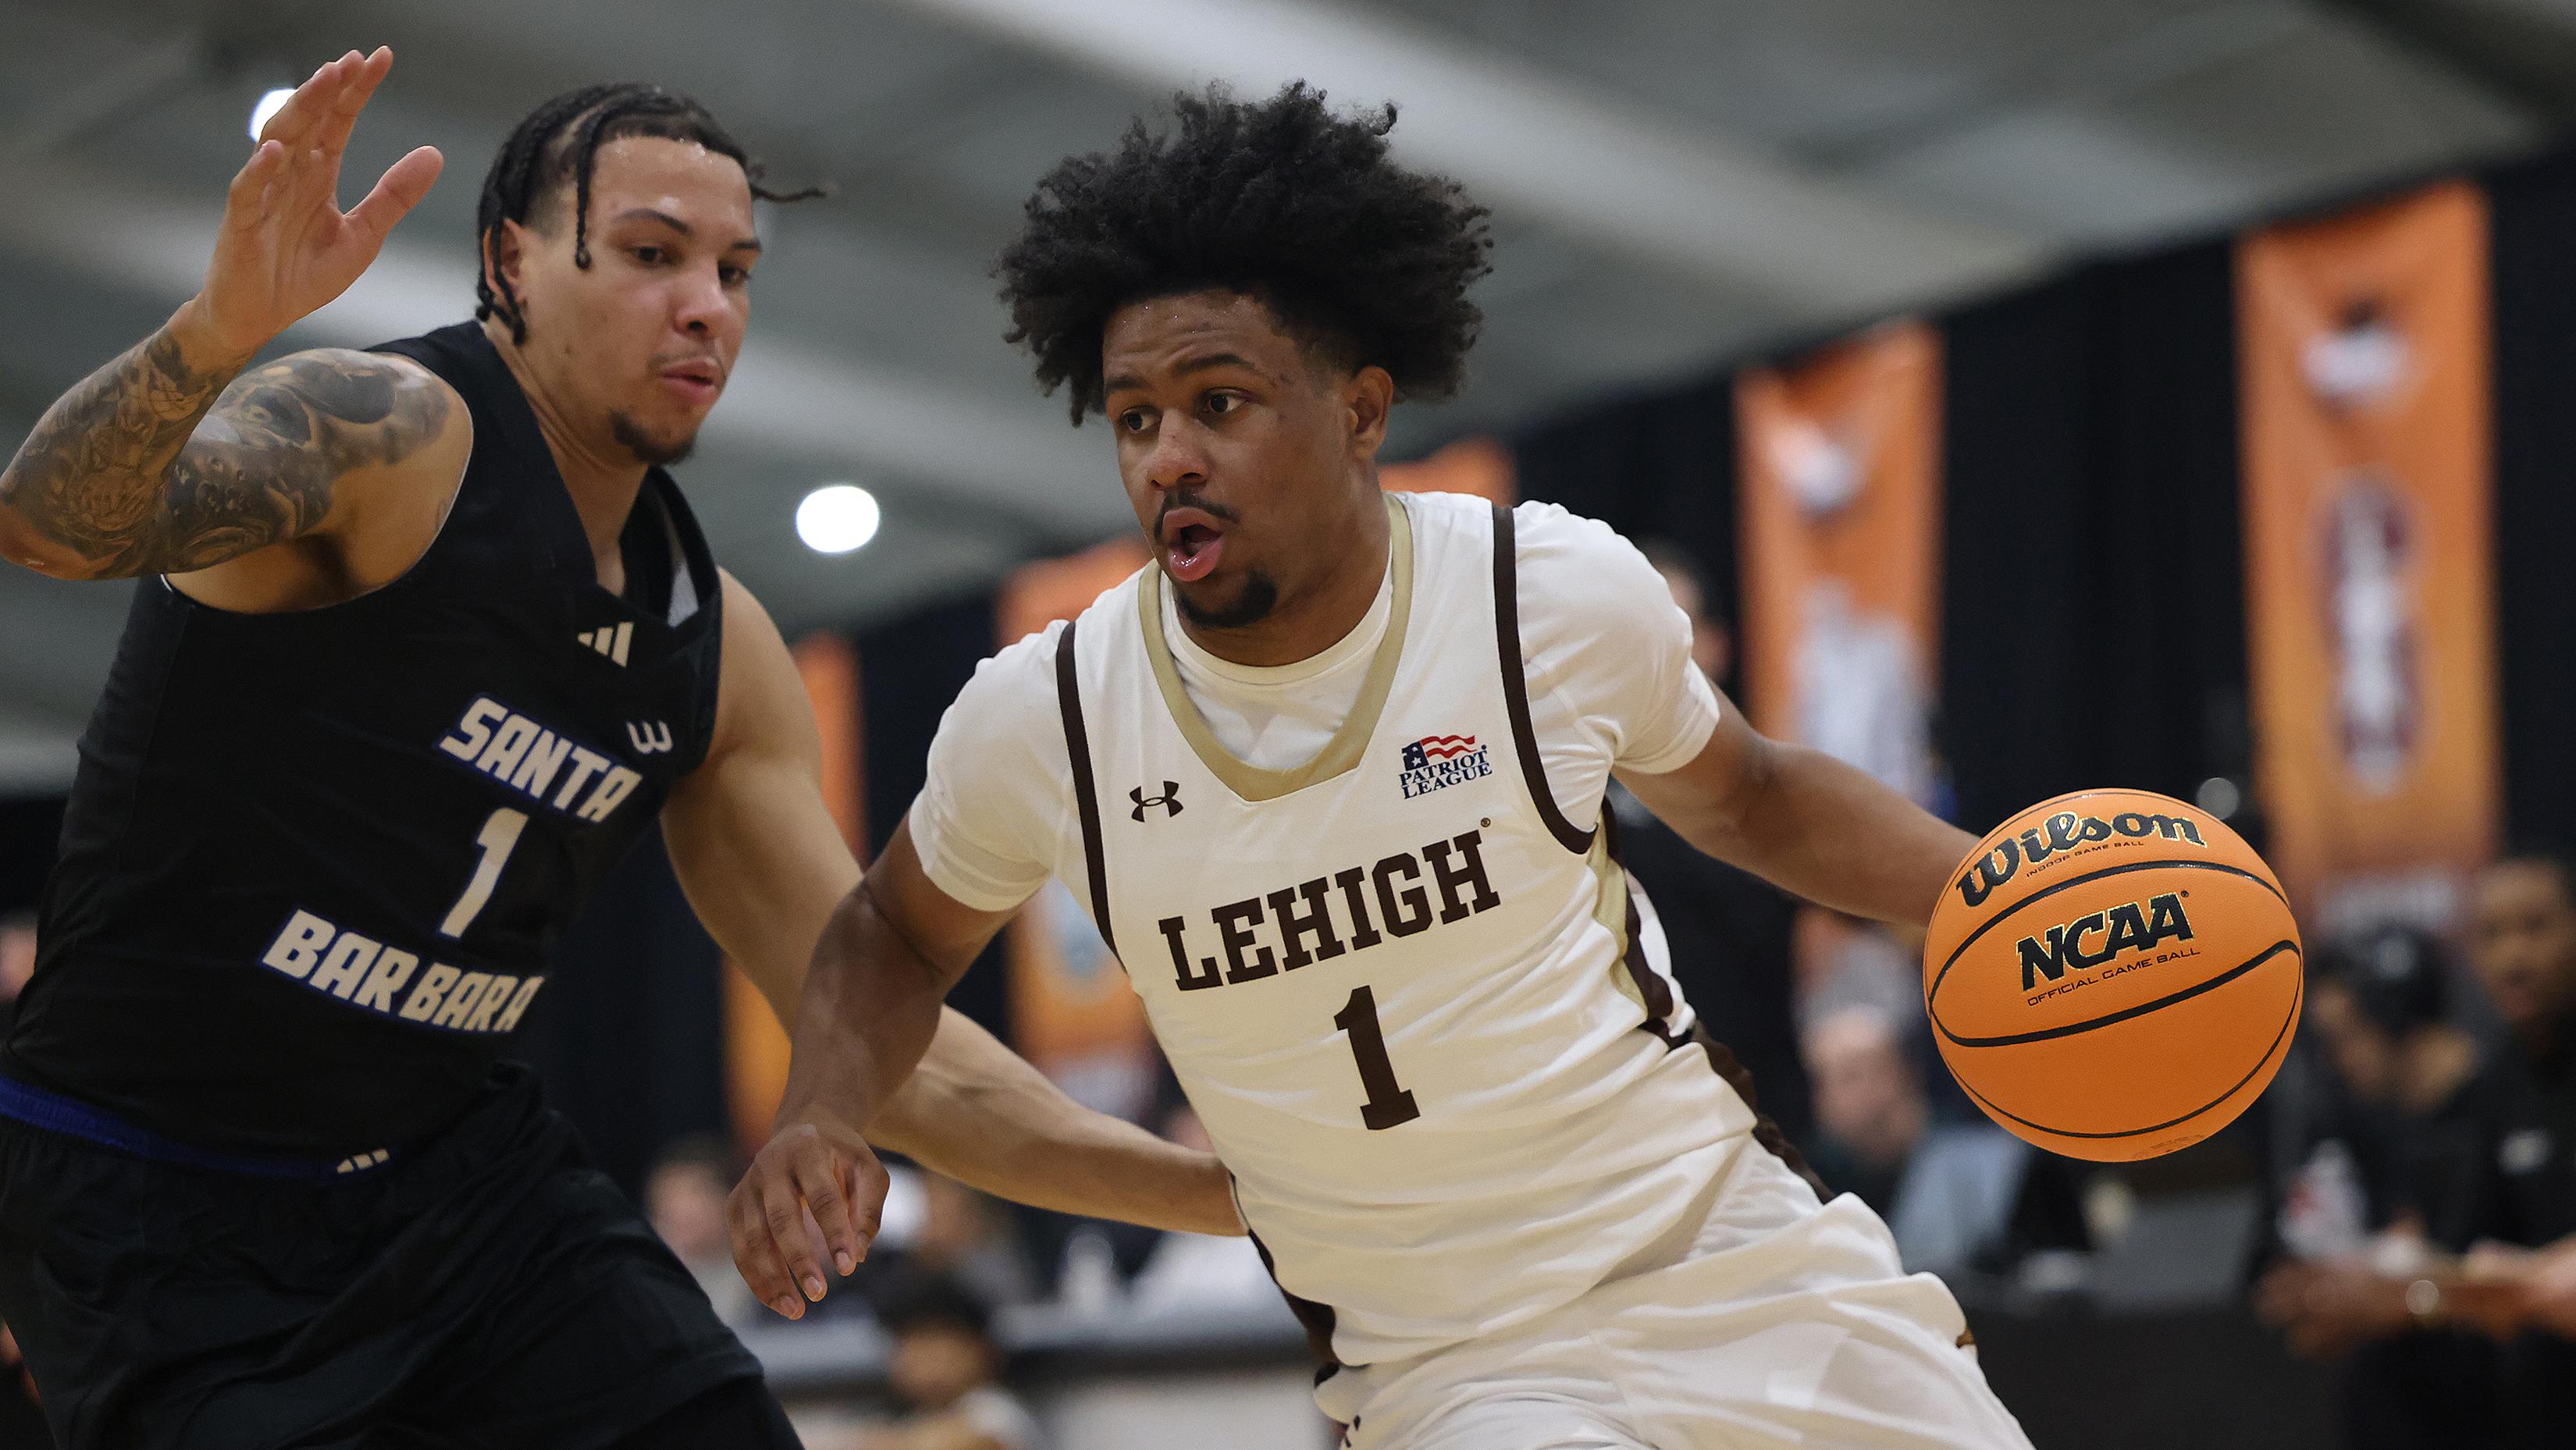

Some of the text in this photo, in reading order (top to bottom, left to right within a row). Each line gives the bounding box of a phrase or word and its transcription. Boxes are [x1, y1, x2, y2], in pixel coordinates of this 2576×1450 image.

[436, 695, 643, 824] SANTA
[1399, 749, 1488, 787] PATRIOT
[1401, 762, 1493, 800] LEAGUE
[439, 806, 530, 939] 1
[1955, 811, 2208, 908] Wilson
[2026, 854, 2070, 878] INDOOR
[2074, 844, 2109, 856] GAME
[1158, 830, 1500, 991] LEHIGH
[2016, 891, 2194, 992] NCAA
[262, 908, 546, 1033] BARBARA
[2027, 947, 2201, 1008] OFFICIAL GAME BALL
[1333, 985, 1421, 1131] 1
